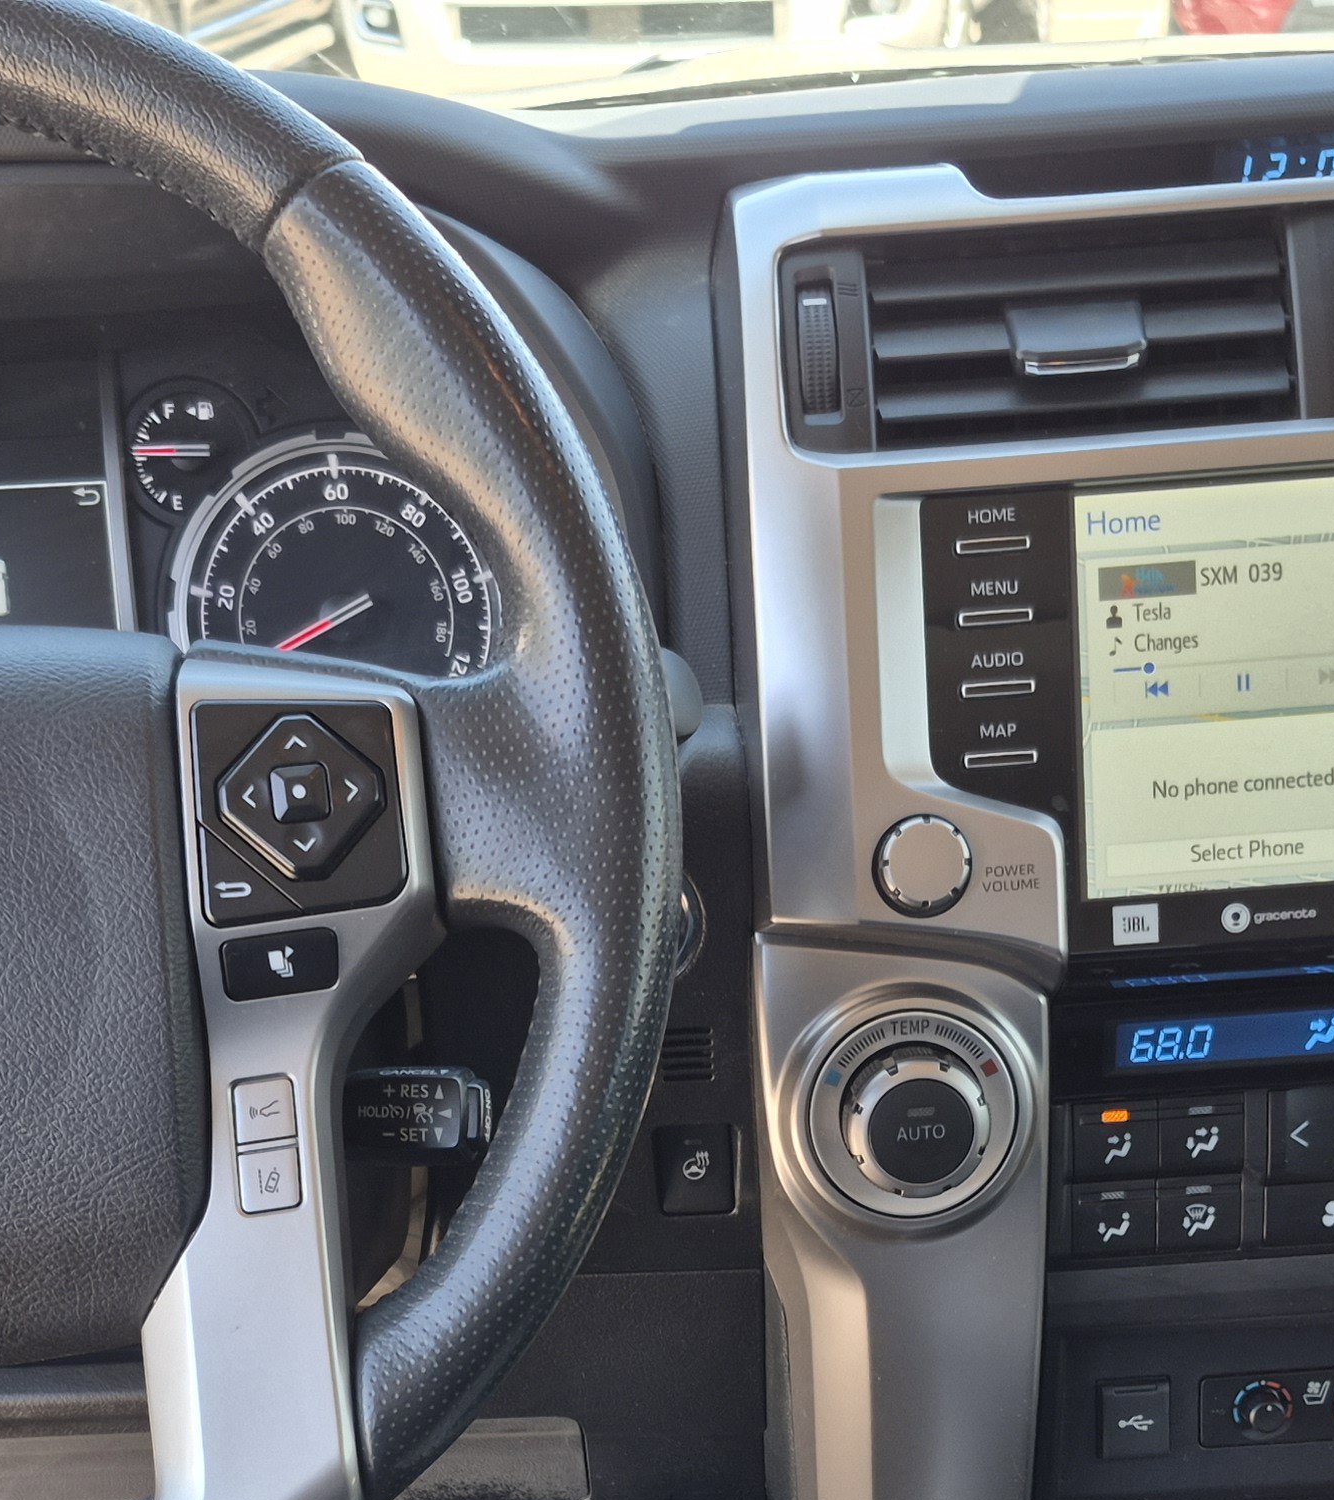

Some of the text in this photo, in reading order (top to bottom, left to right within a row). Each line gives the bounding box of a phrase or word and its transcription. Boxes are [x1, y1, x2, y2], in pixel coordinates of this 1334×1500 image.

[163, 403, 174, 418] F
[324, 483, 349, 501] 60
[173, 496, 183, 511] E
[334, 512, 357, 526] 100
[400, 503, 426, 528] 80
[968, 507, 1016, 524] HOME
[1086, 510, 1161, 536] Home
[251, 513, 275, 537] 40
[297, 519, 315, 534] 80
[374, 520, 395, 538] 120
[267, 543, 283, 560] 60
[407, 543, 426, 565] 140
[1200, 564, 1238, 588] SXM
[1248, 562, 1283, 584] 039
[248, 577, 261, 595] 40
[429, 578, 444, 602] 160
[450, 568, 473, 604] 100
[970, 580, 1019, 596] MENU
[217, 584, 236, 611] 20
[1132, 602, 1171, 623] Tesla
[246, 619, 257, 636] 20
[435, 620, 447, 643] 180
[1134, 633, 1198, 655] Changes
[970, 651, 1025, 669] AUDIO
[979, 722, 1017, 739] MAP
[1152, 780, 1179, 799] No
[1184, 776, 1238, 801] phone
[1190, 840, 1304, 863] Select Phone
[985, 863, 1036, 877] POWER
[982, 877, 1041, 893] VOLUME
[1123, 916, 1150, 933] JBL
[1253, 908, 1317, 925] gracenote
[890, 1019, 931, 1036] TEMP
[1129, 1024, 1213, 1063] 68.0
[400, 1084, 429, 1098] RES
[358, 1105, 389, 1118] HOLD
[400, 1127, 429, 1142] SET
[896, 1125, 946, 1142] AUTO
